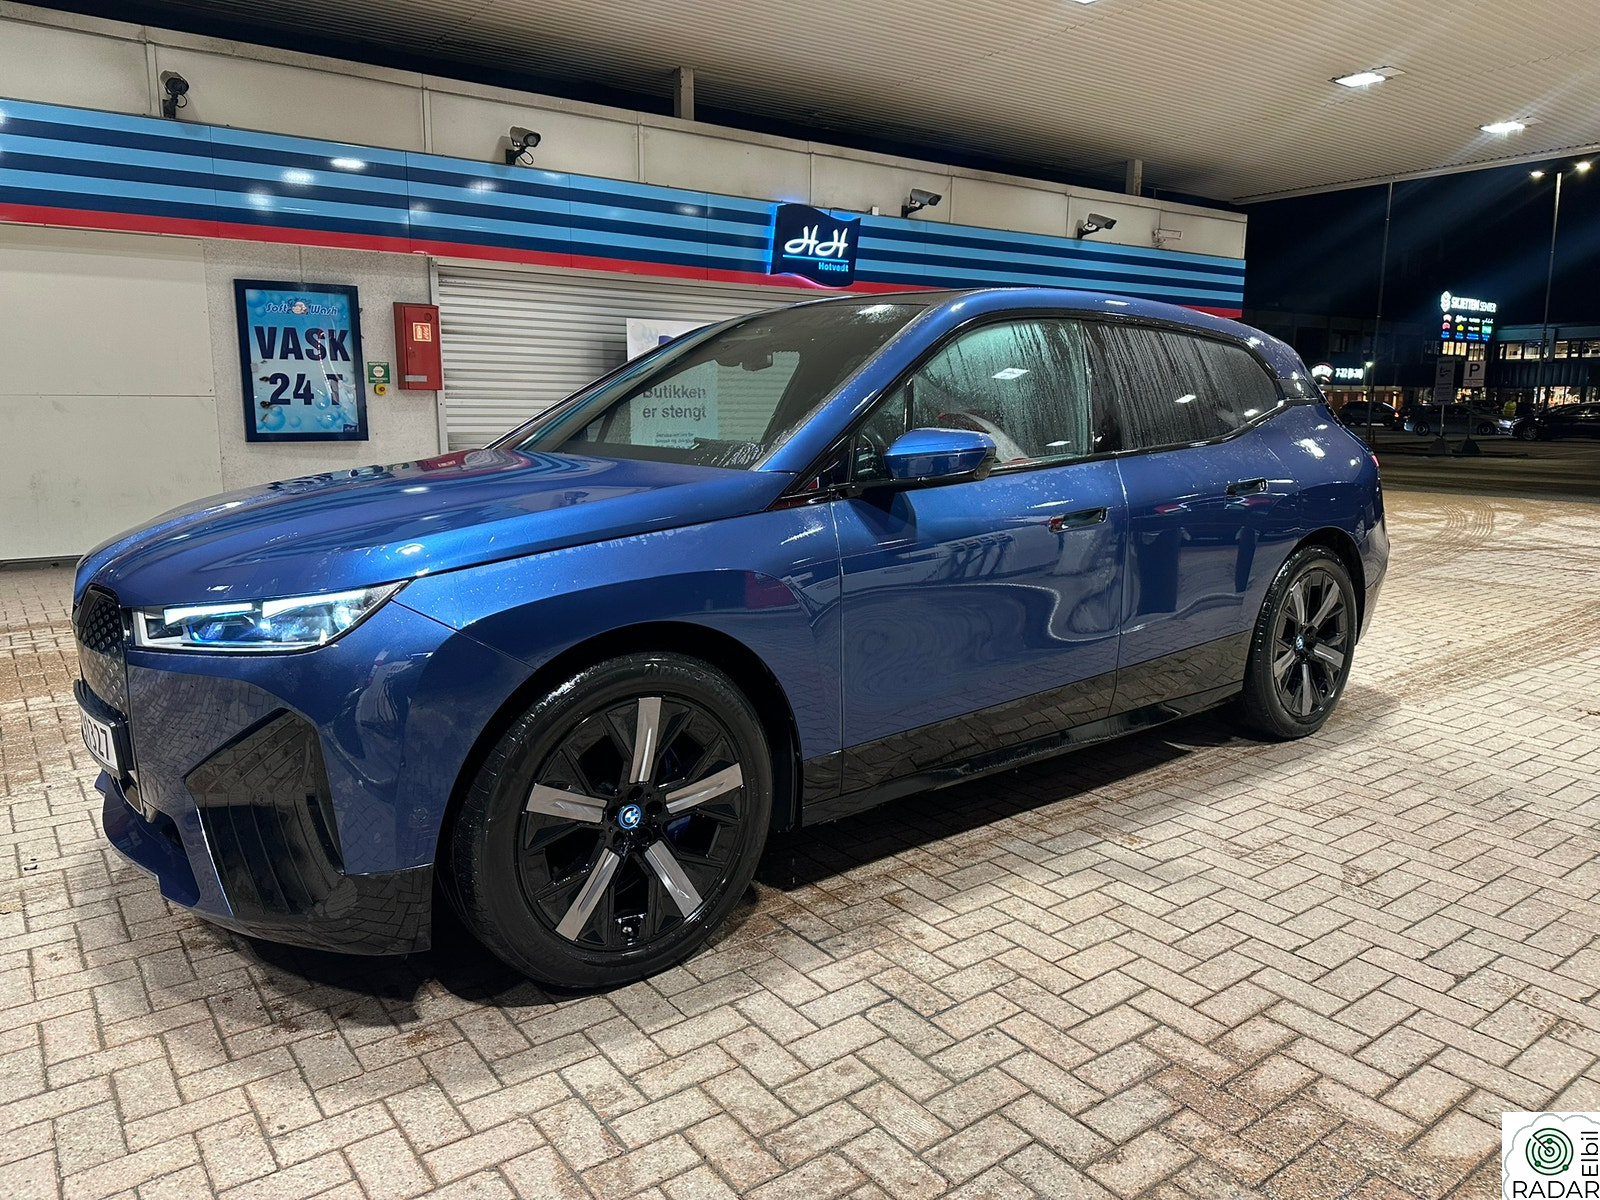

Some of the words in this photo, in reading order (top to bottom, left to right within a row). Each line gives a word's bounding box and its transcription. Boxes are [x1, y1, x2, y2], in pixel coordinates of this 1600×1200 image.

[818, 261, 849, 273] Hotvedt
[265, 302, 288, 313] Soft
[310, 304, 338, 316] Wash
[254, 325, 351, 362] VASK
[1469, 363, 1480, 378] P
[269, 372, 315, 406] 24
[328, 373, 343, 406] T
[642, 384, 706, 399] Butikken
[642, 407, 657, 419] er
[661, 405, 707, 421] stengt
